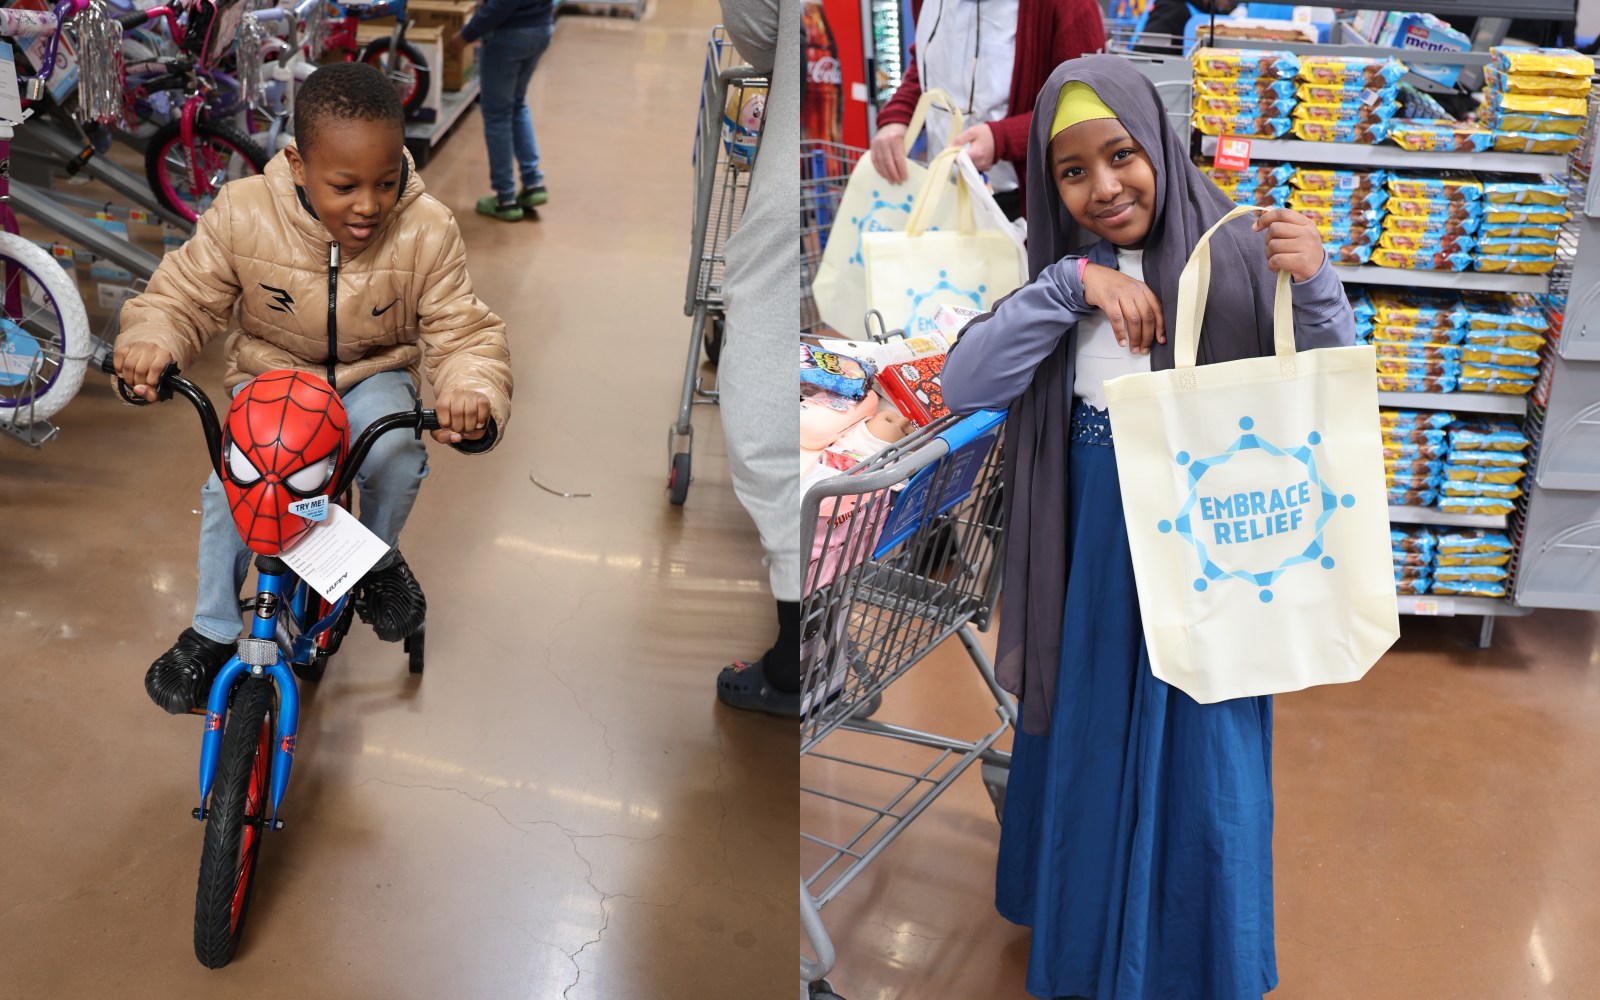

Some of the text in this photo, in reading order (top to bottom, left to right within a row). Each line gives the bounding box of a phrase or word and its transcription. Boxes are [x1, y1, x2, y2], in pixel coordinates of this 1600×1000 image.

[295, 498, 325, 512] TRY ME!
[1199, 480, 1311, 521] EMBRACE
[1213, 508, 1303, 545] RELIEF
